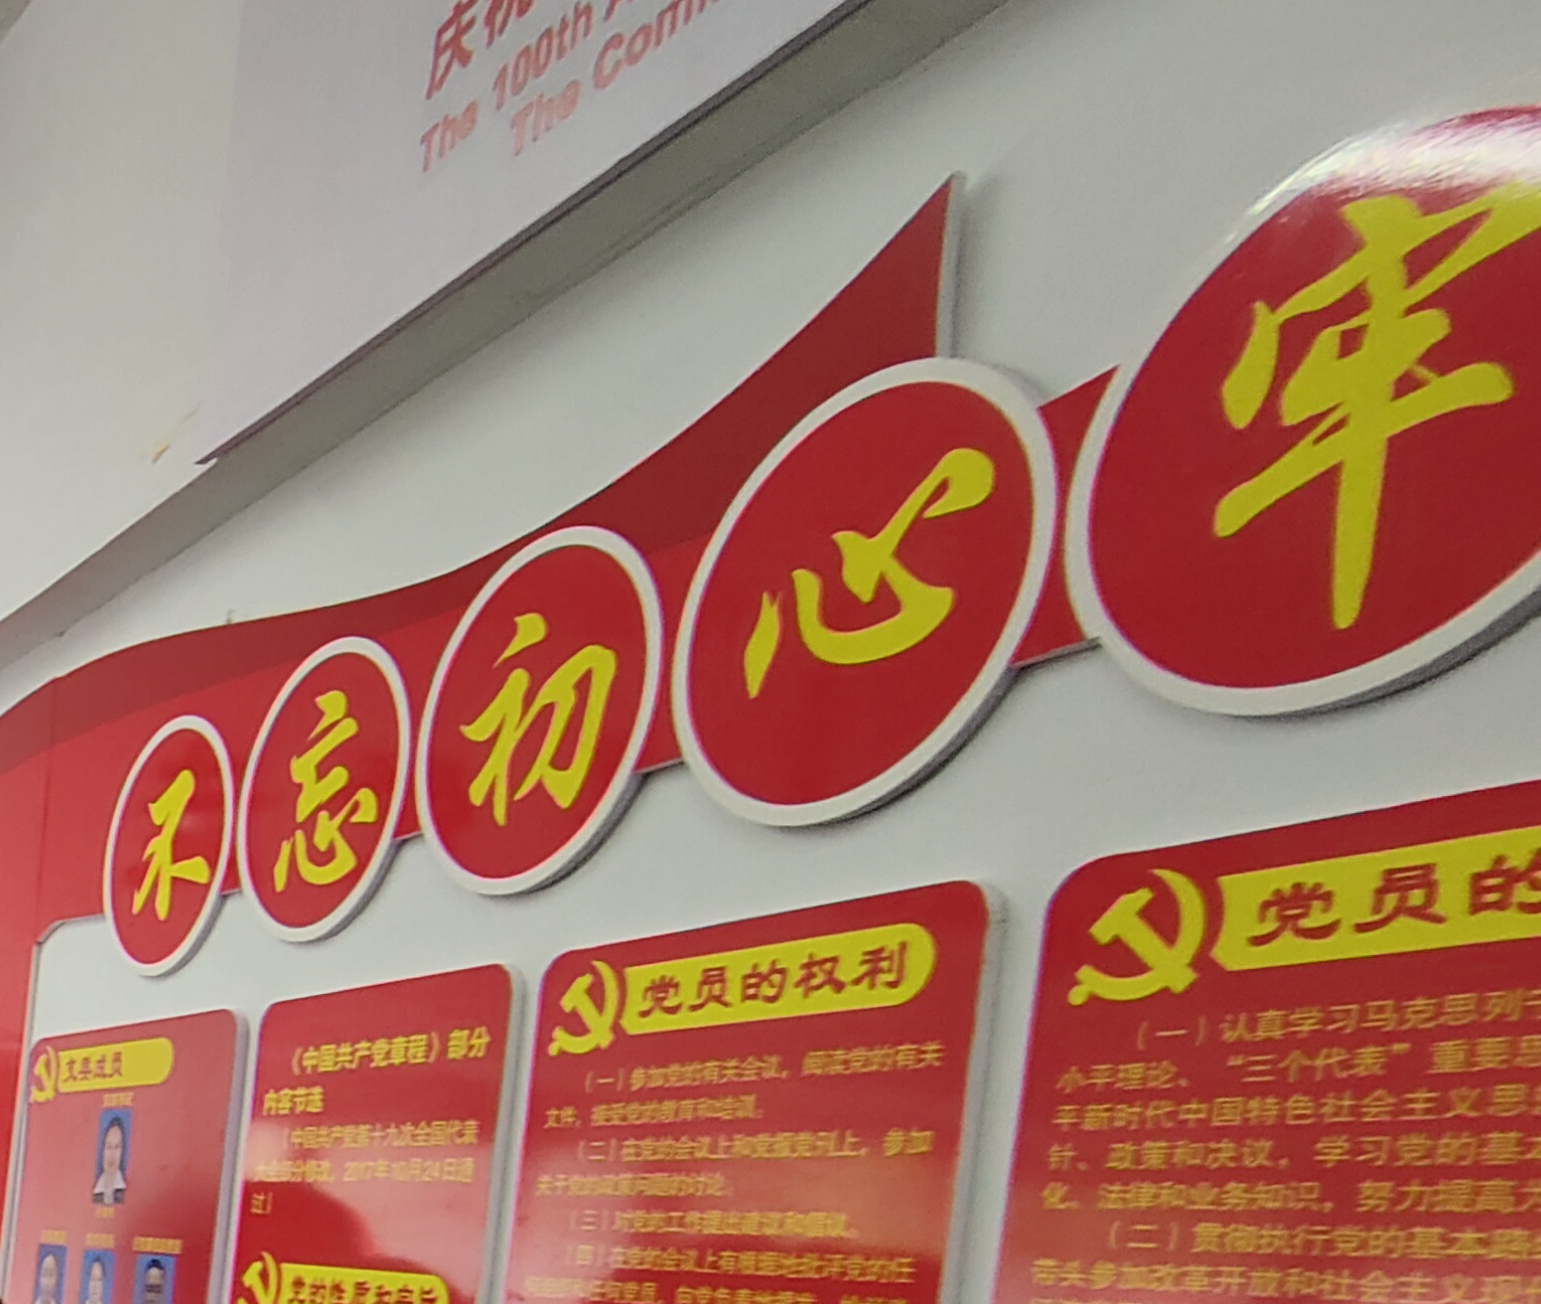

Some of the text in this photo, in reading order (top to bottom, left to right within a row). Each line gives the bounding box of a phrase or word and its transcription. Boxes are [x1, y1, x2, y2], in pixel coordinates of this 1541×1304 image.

[420, 1, 594, 173] The 100th
[510, 79, 580, 157] The
[1246, 849, 1541, 945] 党员的
[637, 940, 908, 1017] 党员的权利
[1051, 1082, 1541, 1133] 平新时代中国特色社会主义思
[1107, 1223, 1541, 1260] （二）贯彻执行党的基本路
